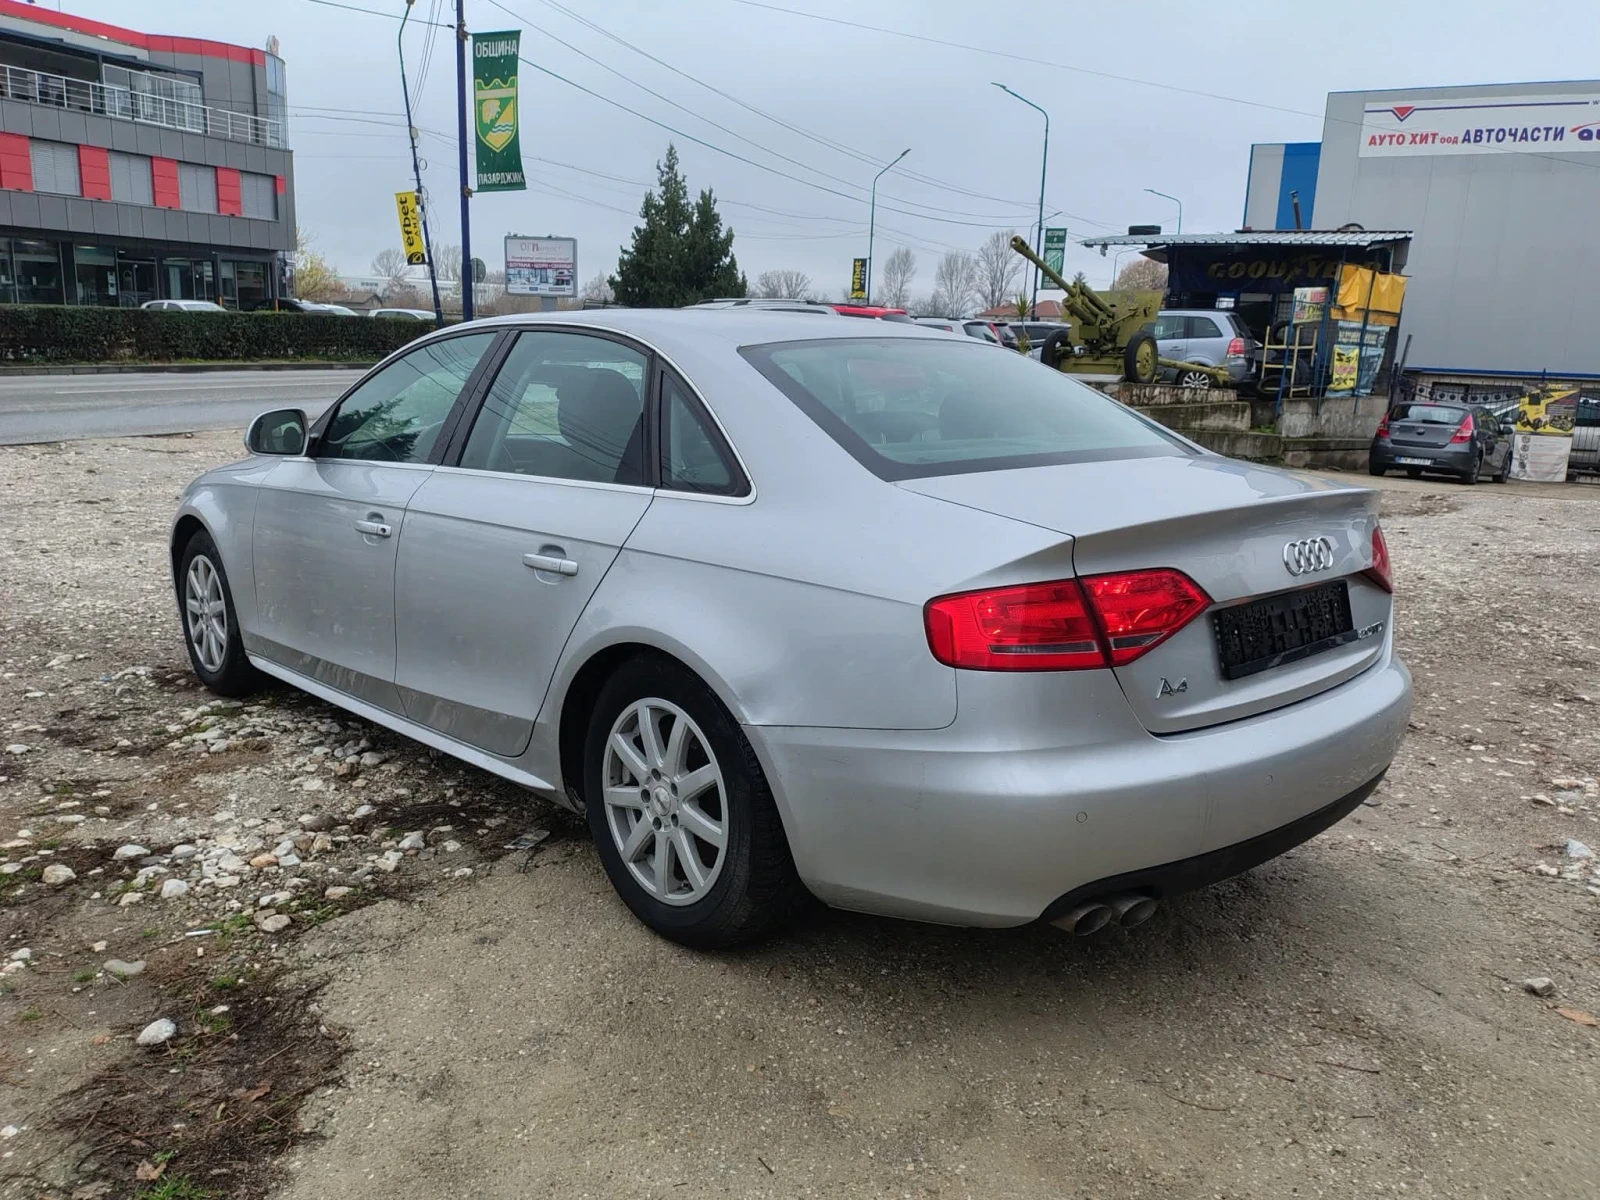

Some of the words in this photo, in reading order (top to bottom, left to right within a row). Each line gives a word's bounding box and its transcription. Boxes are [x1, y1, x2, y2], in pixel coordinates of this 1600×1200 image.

[475, 40, 518, 58] ОБЩИНА
[1368, 134, 1406, 147] АУТО
[1409, 132, 1439, 145] ХИТ
[1461, 126, 1565, 145] АВТОЧАСТИ
[478, 171, 524, 185] ПАЗАРДЖИК
[400, 196, 414, 247] efbet
[1156, 676, 1188, 700] A4
